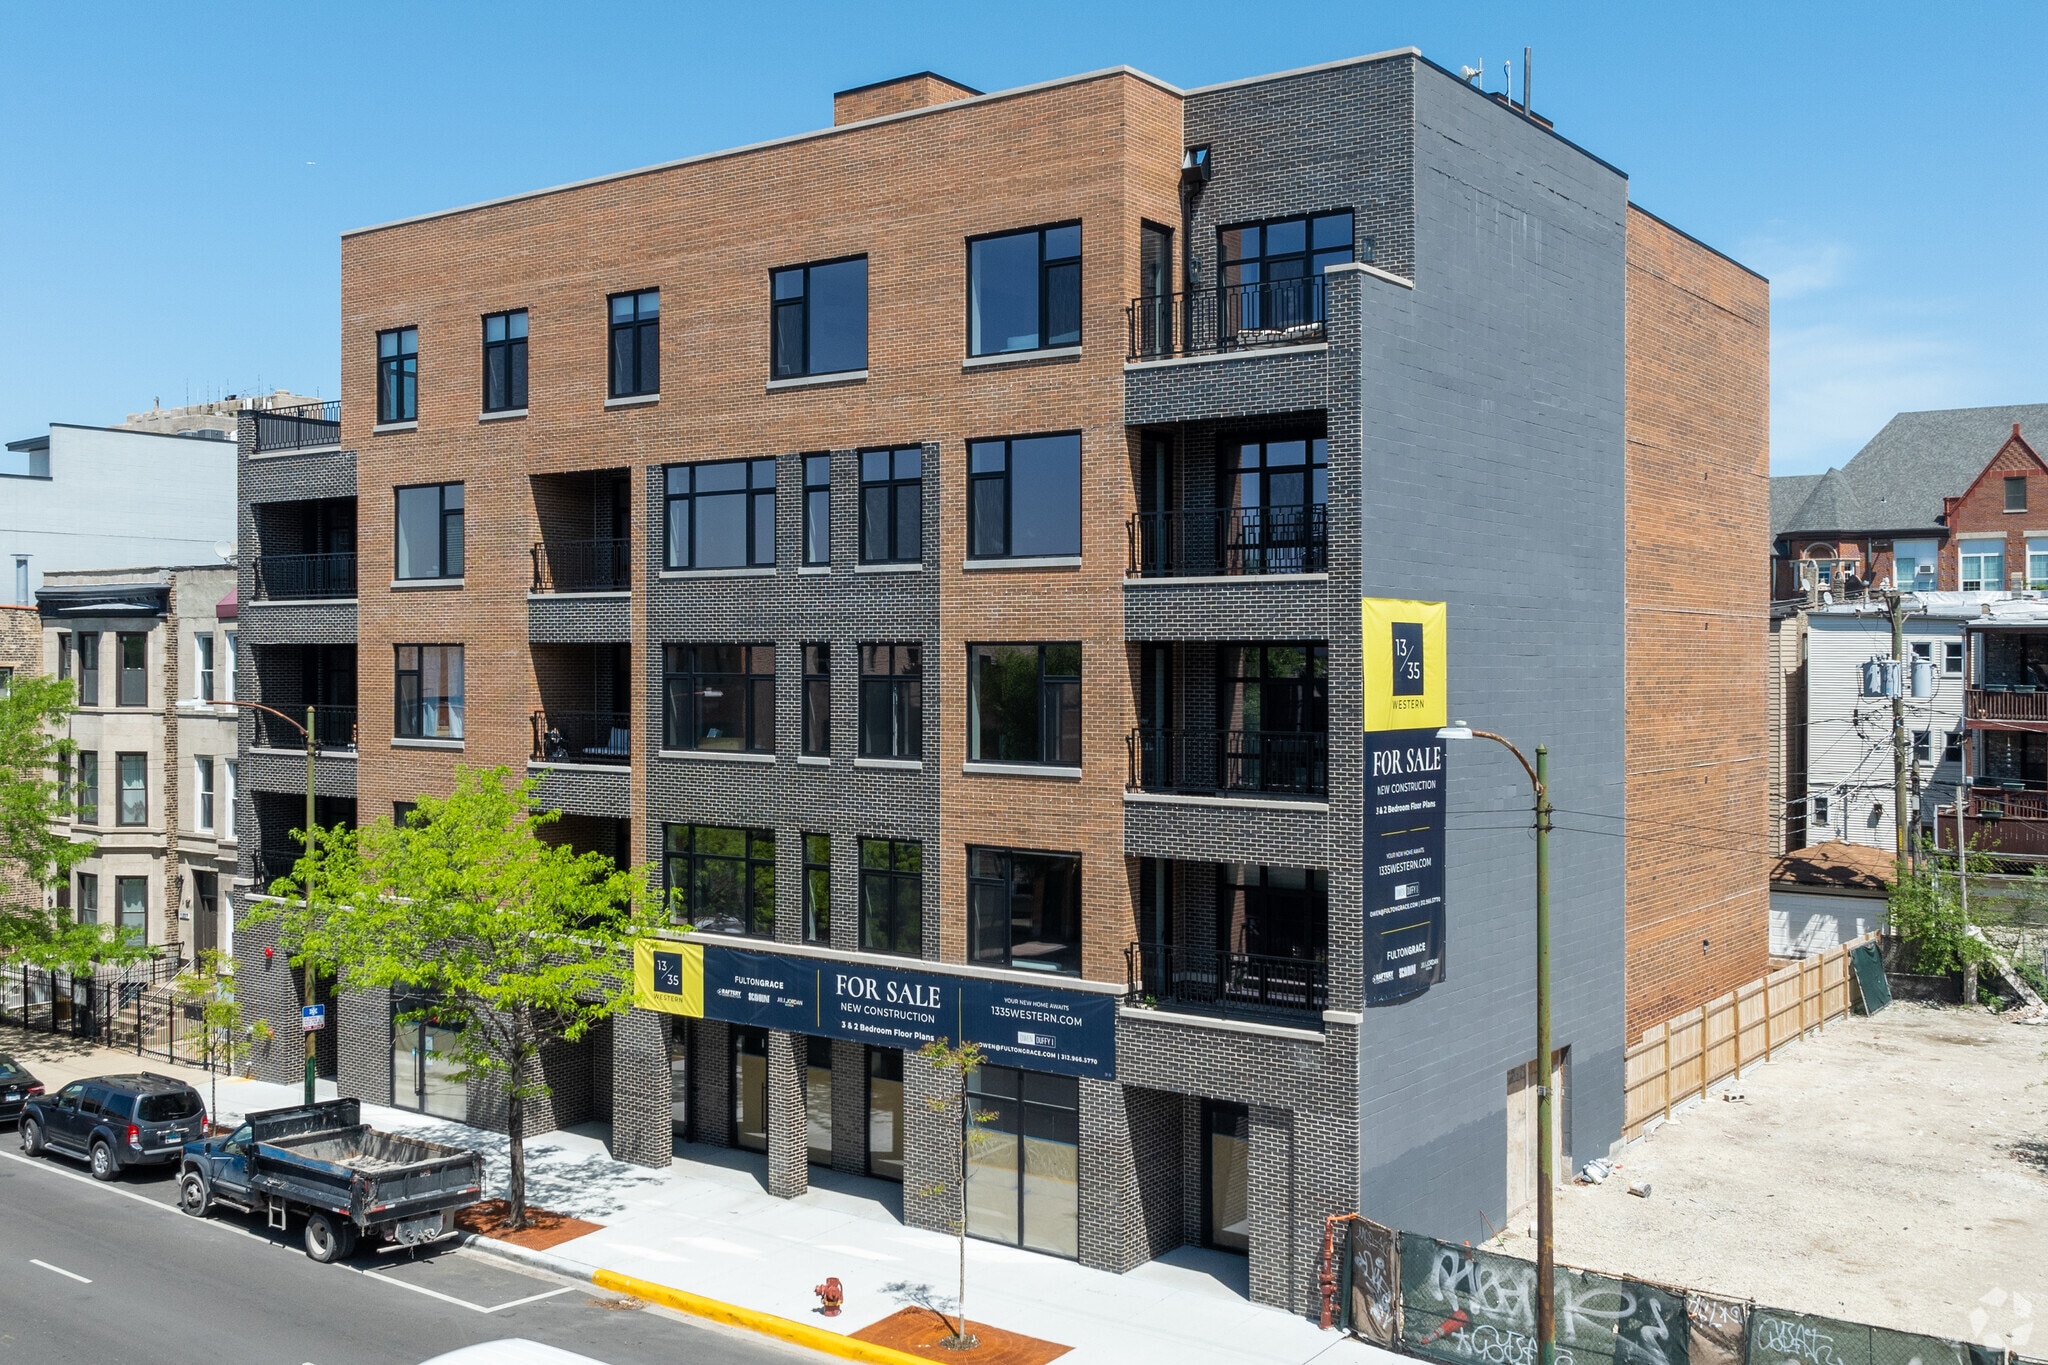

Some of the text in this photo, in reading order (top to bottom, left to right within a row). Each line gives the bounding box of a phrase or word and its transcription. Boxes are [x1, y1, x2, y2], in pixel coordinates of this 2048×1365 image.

[1395, 638, 1407, 656] 13
[1407, 662, 1420, 680] 35
[1392, 700, 1424, 710] WESTERN
[1373, 746, 1441, 776] FOR SALE
[1377, 780, 1436, 796] NEW CONSTRUCTION
[1388, 803, 1410, 813] Bedroom
[1379, 857, 1432, 876] 1335WESTERN.COM
[1386, 942, 1426, 960] FULTONGRACE
[657, 960, 667, 971] 13
[667, 974, 679, 986] 35
[734, 975, 784, 990] FULTONGRACE
[654, 993, 683, 1003] WESTERN
[836, 974, 940, 1008] FOR SALE
[840, 1002, 935, 1023] NEW CONSTRUCTION
[991, 1006, 1082, 1026] 1335WESTERN.COM
[854, 1022, 859, 1031] 2
[860, 1024, 892, 1035] Bedroom
[894, 1029, 912, 1038] Floor
[914, 1032, 935, 1041] Plans
[1036, 1036, 1050, 1045] DUFFY
[979, 1042, 1056, 1058] OWEN@FULTONGRACE.COM
